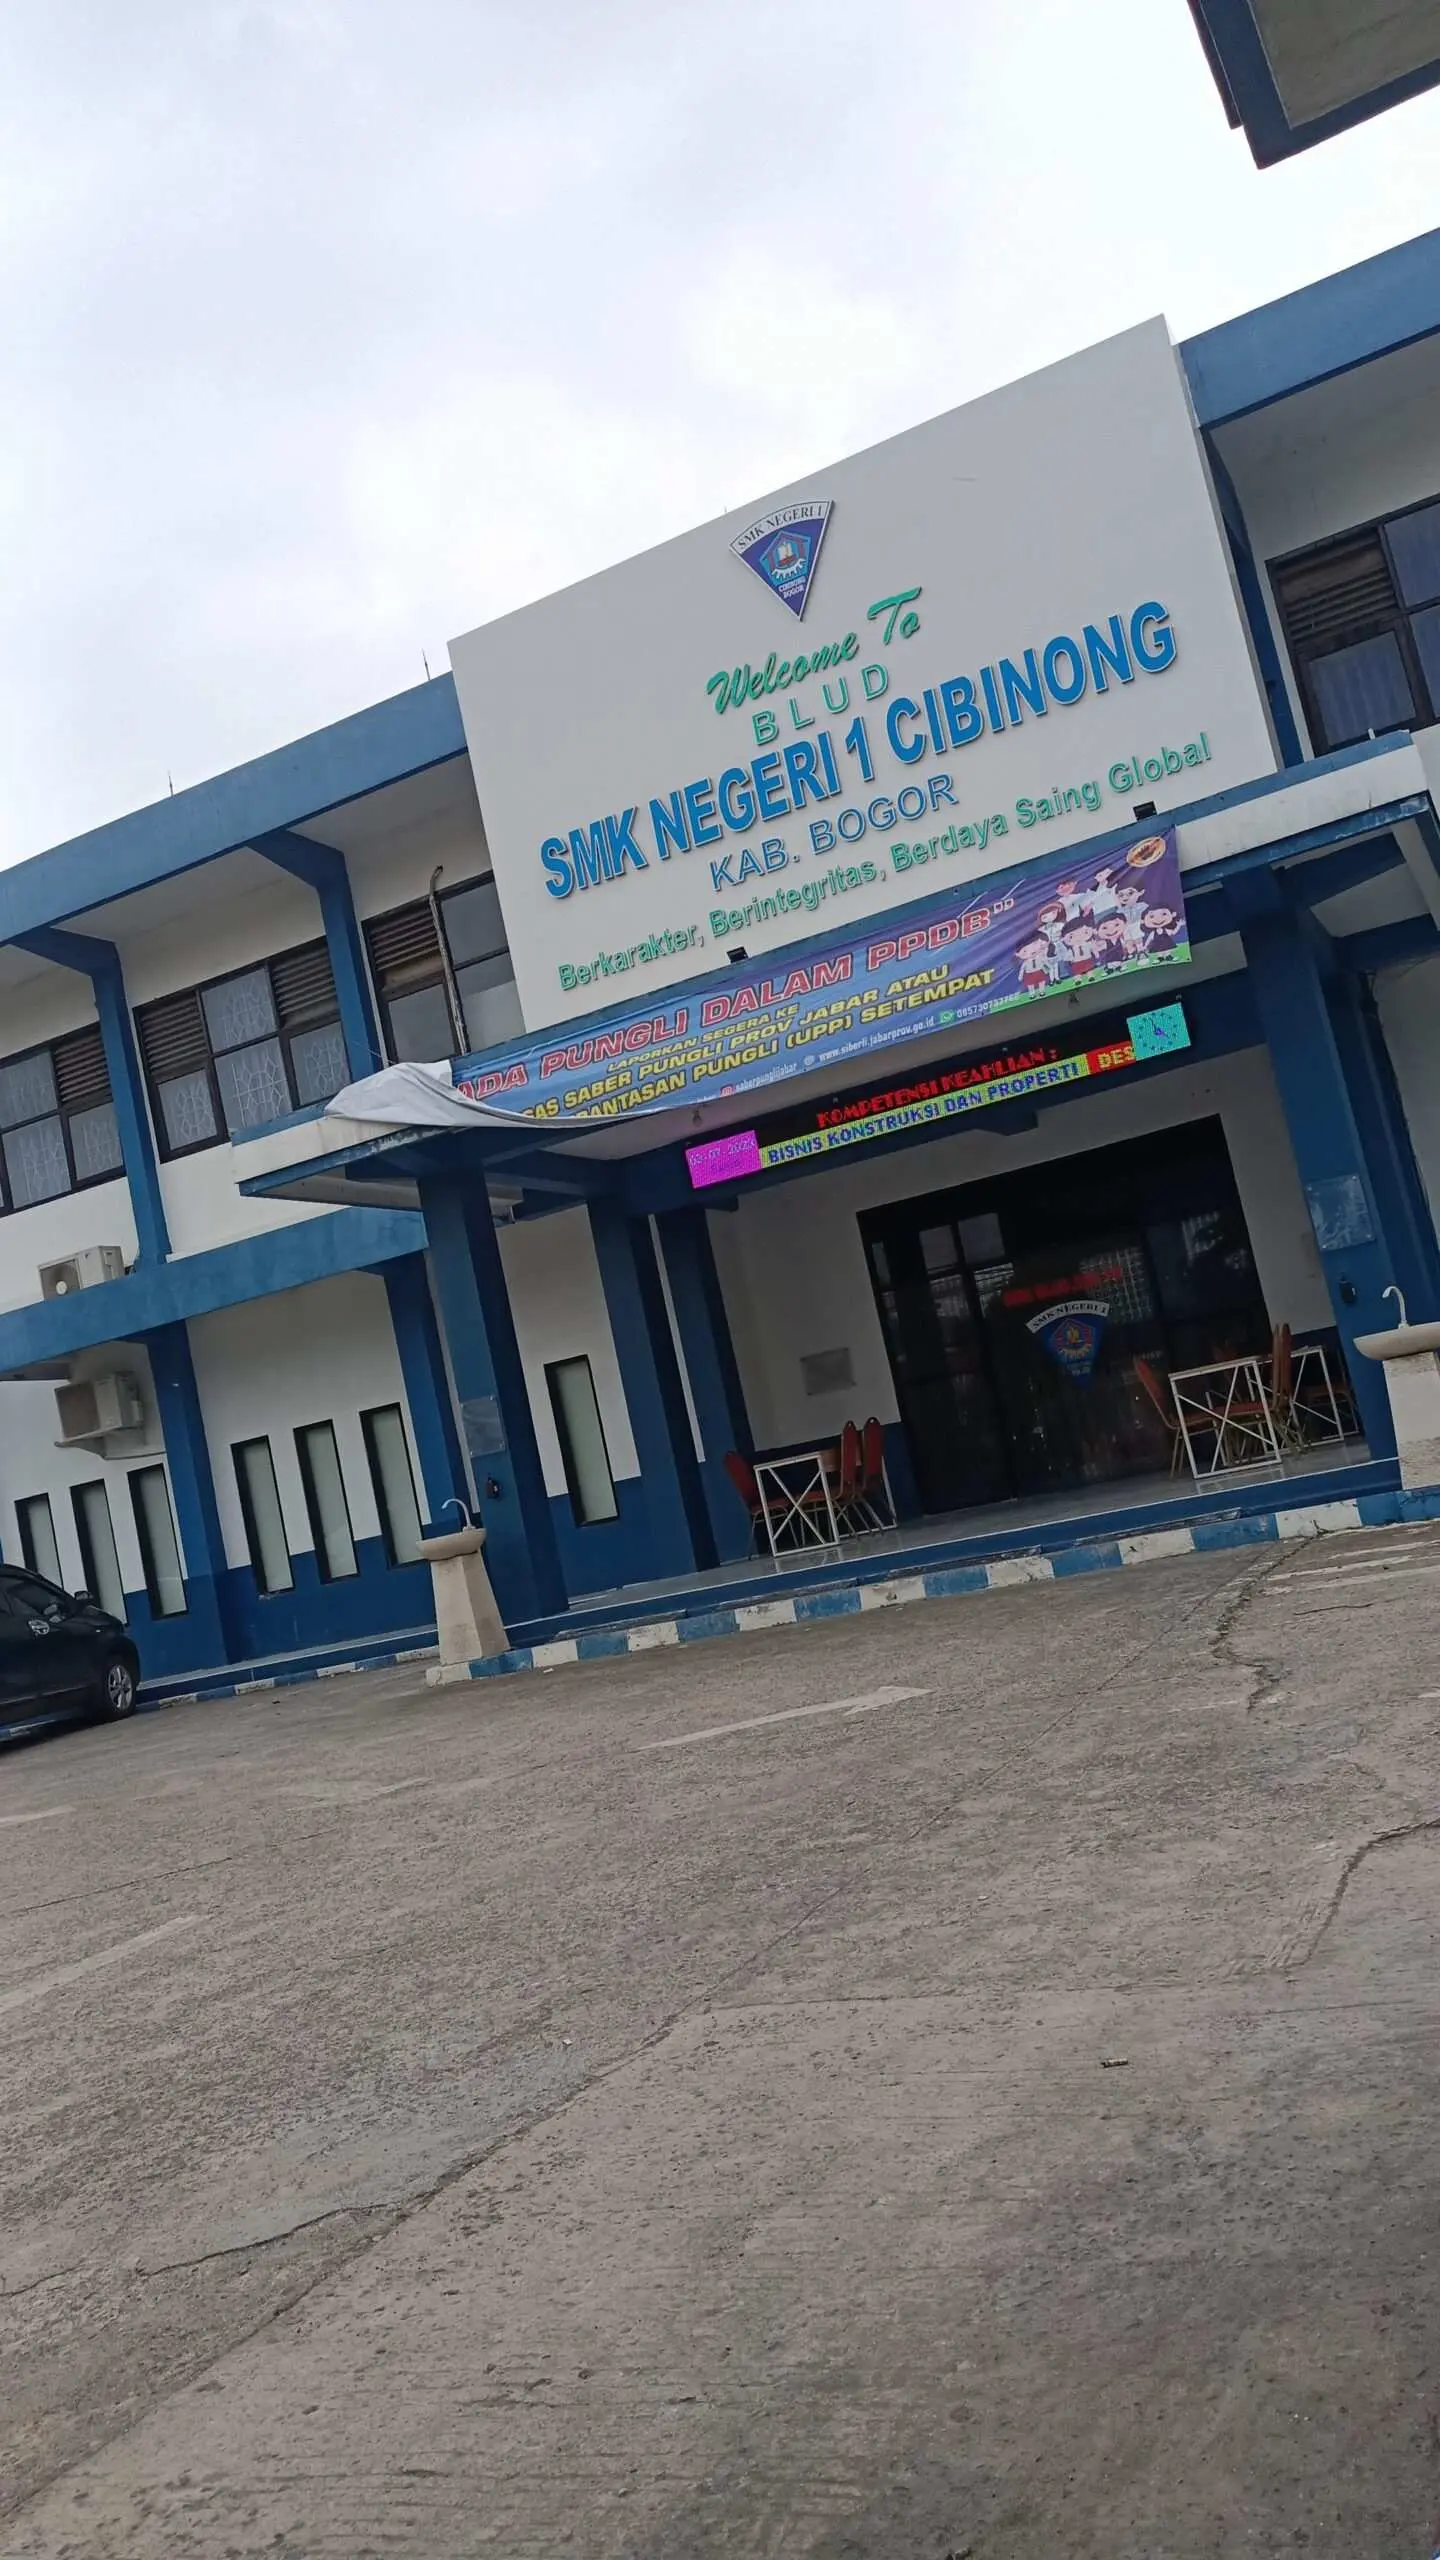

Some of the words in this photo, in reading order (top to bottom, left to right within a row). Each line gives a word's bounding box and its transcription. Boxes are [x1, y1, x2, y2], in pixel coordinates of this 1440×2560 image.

[738, 526, 765, 550] SMK
[767, 505, 815, 528] NEGERI
[706, 632, 859, 714] Welcome
[867, 585, 922, 647] To
[540, 804, 649, 899] SMK
[648, 730, 843, 861] NEGERI
[844, 714, 875, 782] 1
[885, 600, 1178, 765] CIBINONG
[557, 924, 705, 991] Berkarakter,
[708, 860, 887, 938] Berintegritas,
[889, 813, 1009, 873] Berdaya
[1014, 780, 1104, 829] Saing
[1107, 731, 1213, 794] Global
[709, 837, 801, 891] KAB.
[808, 773, 960, 855] BOGOR
[541, 1007, 689, 1080] PUNGLI
[702, 953, 852, 1027] DALAM
[564, 1071, 632, 1108] SABER
[639, 1042, 722, 1082] PUNGLI
[730, 1020, 792, 1051] PROV
[798, 988, 879, 1025] JABAR
[886, 964, 950, 997] ATAU
[607, 1037, 698, 1072] LAPORKAN
[702, 1014, 770, 1043] SEGERA
[776, 1003, 799, 1019] KE
[692, 1039, 779, 1083] PUNGLI
[786, 1014, 851, 1050] (UPP)
[859, 968, 995, 1024] SETEMPAT
[768, 1135, 823, 1164] BISNIS
[826, 1102, 940, 1146] KONSTRUKSI
[945, 1091, 983, 1113] DAN
[987, 1062, 1080, 1100] PROPERTI
[816, 1080, 939, 1129] KOMPETENSI
